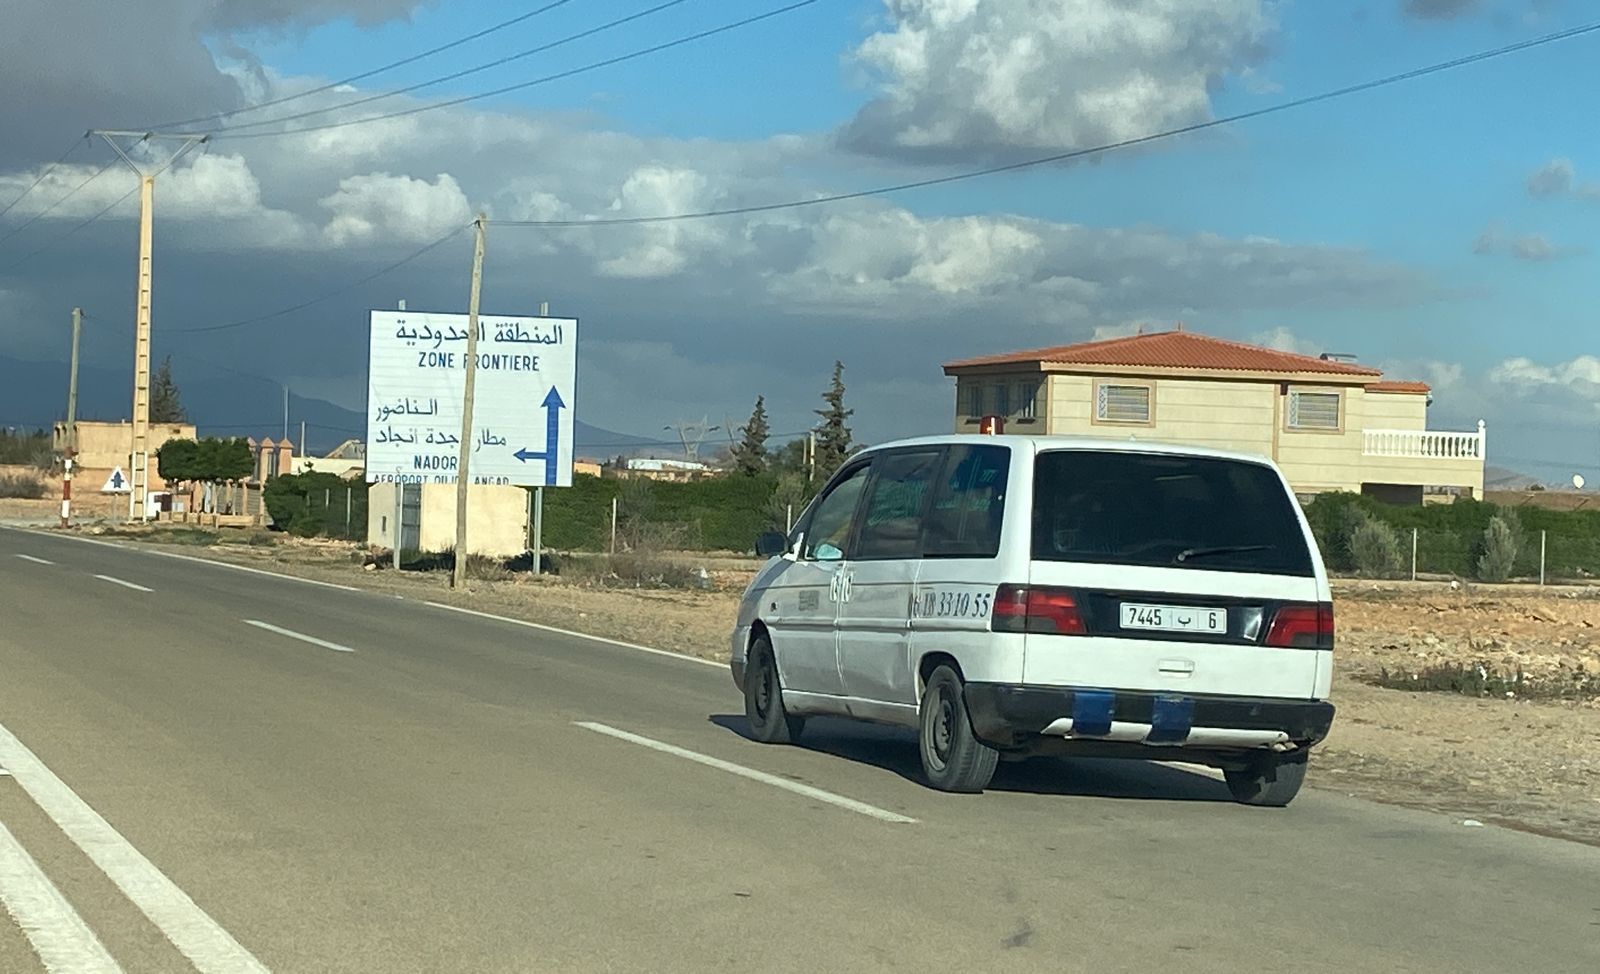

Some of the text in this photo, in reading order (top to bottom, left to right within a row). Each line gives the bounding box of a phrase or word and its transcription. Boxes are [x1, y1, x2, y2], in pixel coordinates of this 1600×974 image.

[396, 319, 563, 349] المنطقة الحدودية
[418, 351, 540, 372] ZONE FRONTIERE
[375, 397, 438, 422] الناضور
[425, 427, 460, 448] جدة
[474, 428, 507, 452] مطار
[413, 454, 459, 471] NADOR
[971, 592, 991, 618] 55
[1128, 607, 1217, 629] 7445 ب 6
